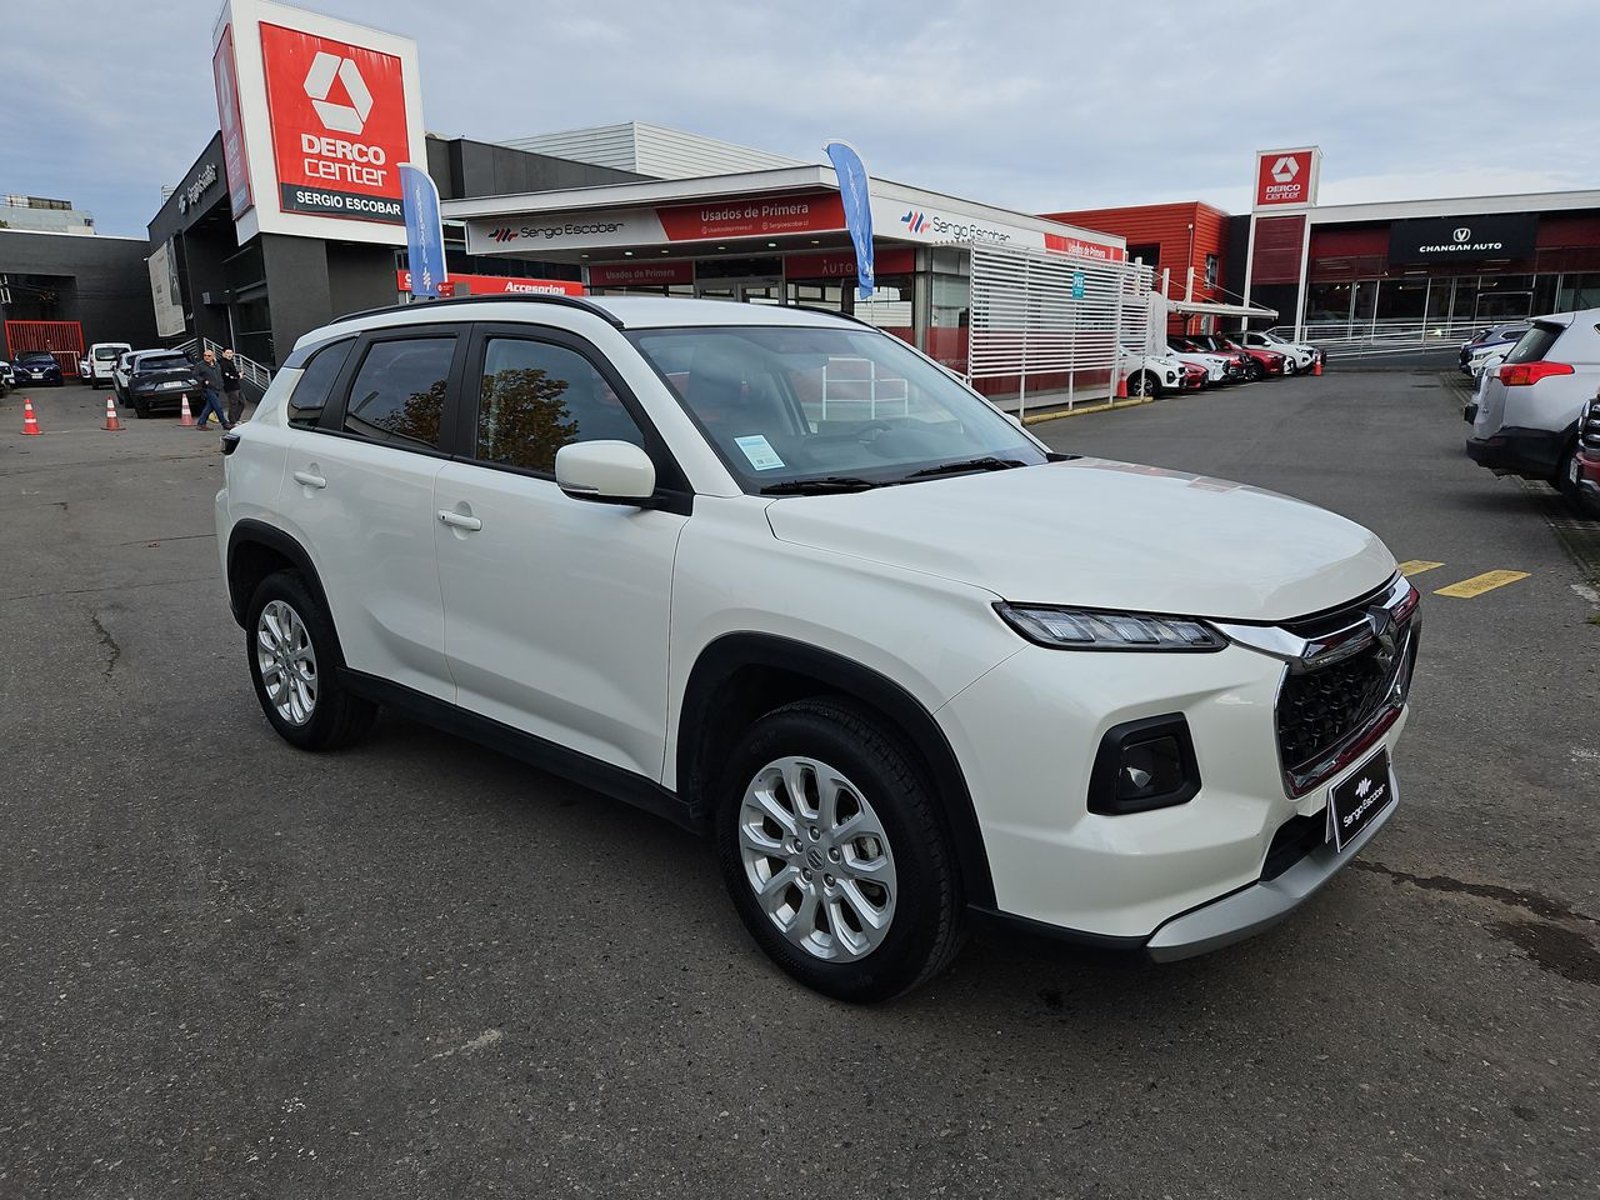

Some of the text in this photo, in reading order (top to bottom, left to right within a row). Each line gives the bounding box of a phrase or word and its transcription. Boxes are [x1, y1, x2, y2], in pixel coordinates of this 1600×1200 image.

[301, 133, 386, 166] DERCO
[304, 158, 388, 187] center
[1266, 184, 1301, 193] DERCO
[296, 190, 402, 216] SERGIO ESCOBAR
[701, 203, 809, 222] Usados de Primera
[564, 221, 625, 235] Escobar
[1419, 242, 1502, 253] CHANGAN AUTO
